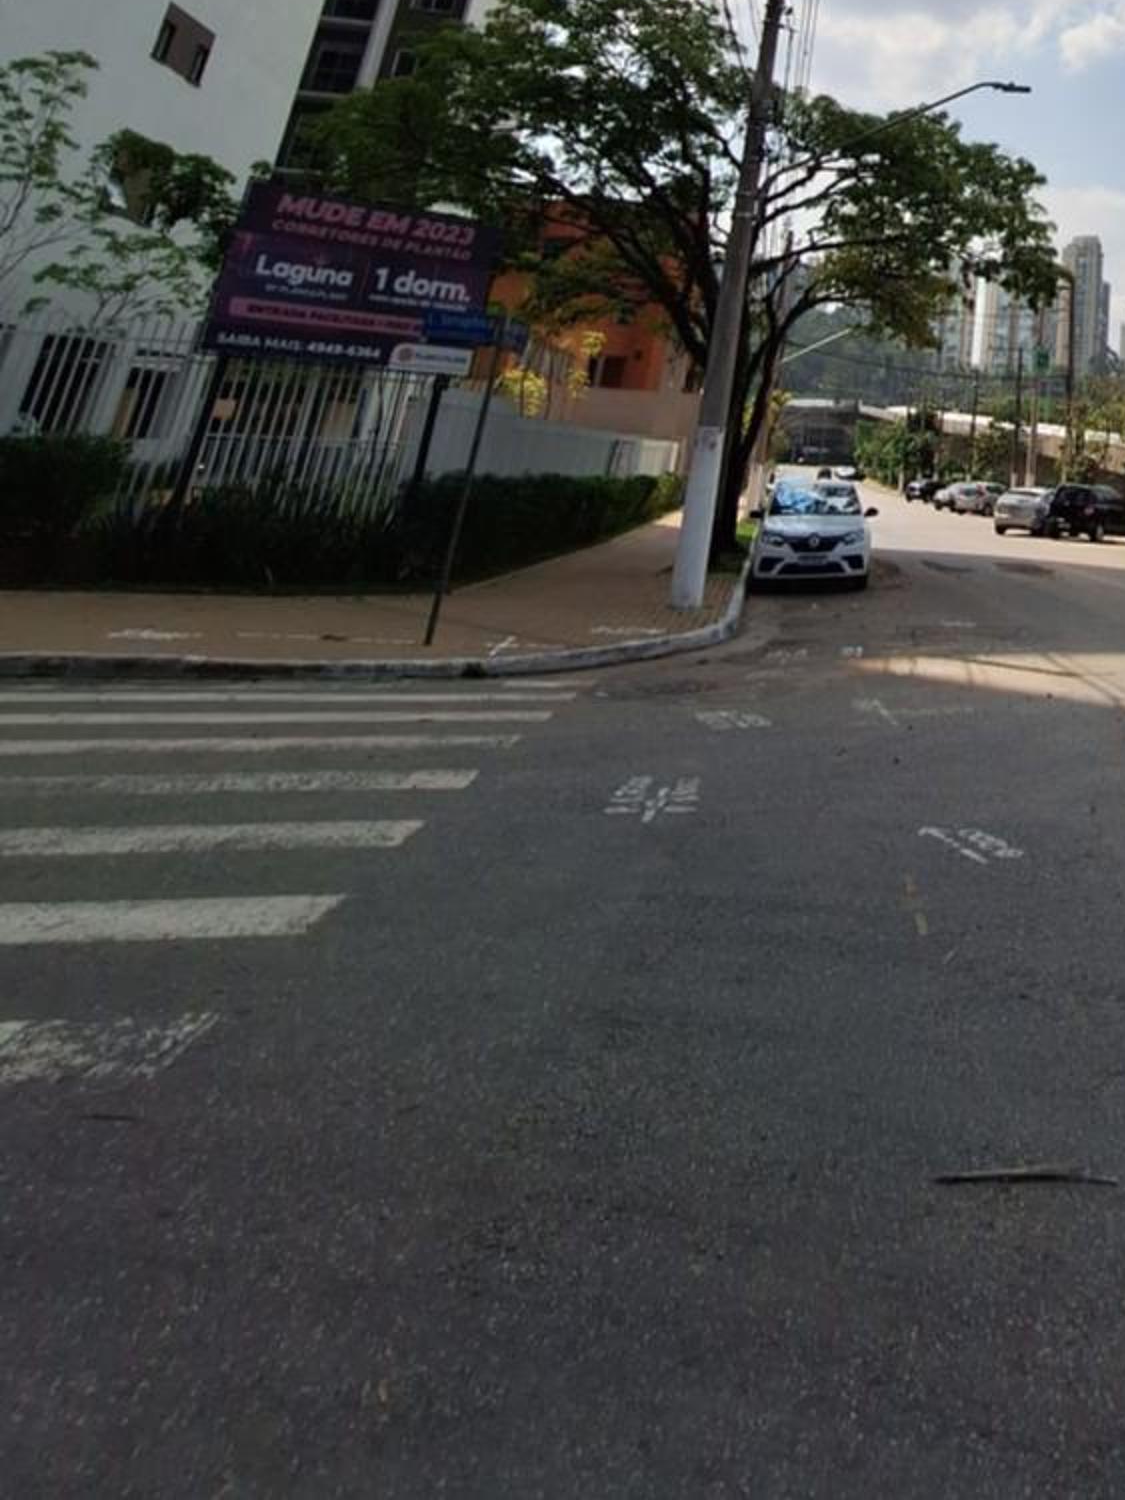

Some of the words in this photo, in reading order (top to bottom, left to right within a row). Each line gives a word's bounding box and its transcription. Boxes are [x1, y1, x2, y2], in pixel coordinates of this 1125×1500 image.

[276, 194, 365, 227] MUDE
[367, 210, 411, 234] EM
[412, 218, 476, 245] 2023
[255, 254, 354, 287] Laguna
[375, 267, 390, 292] 1
[394, 270, 471, 303] dorm.
